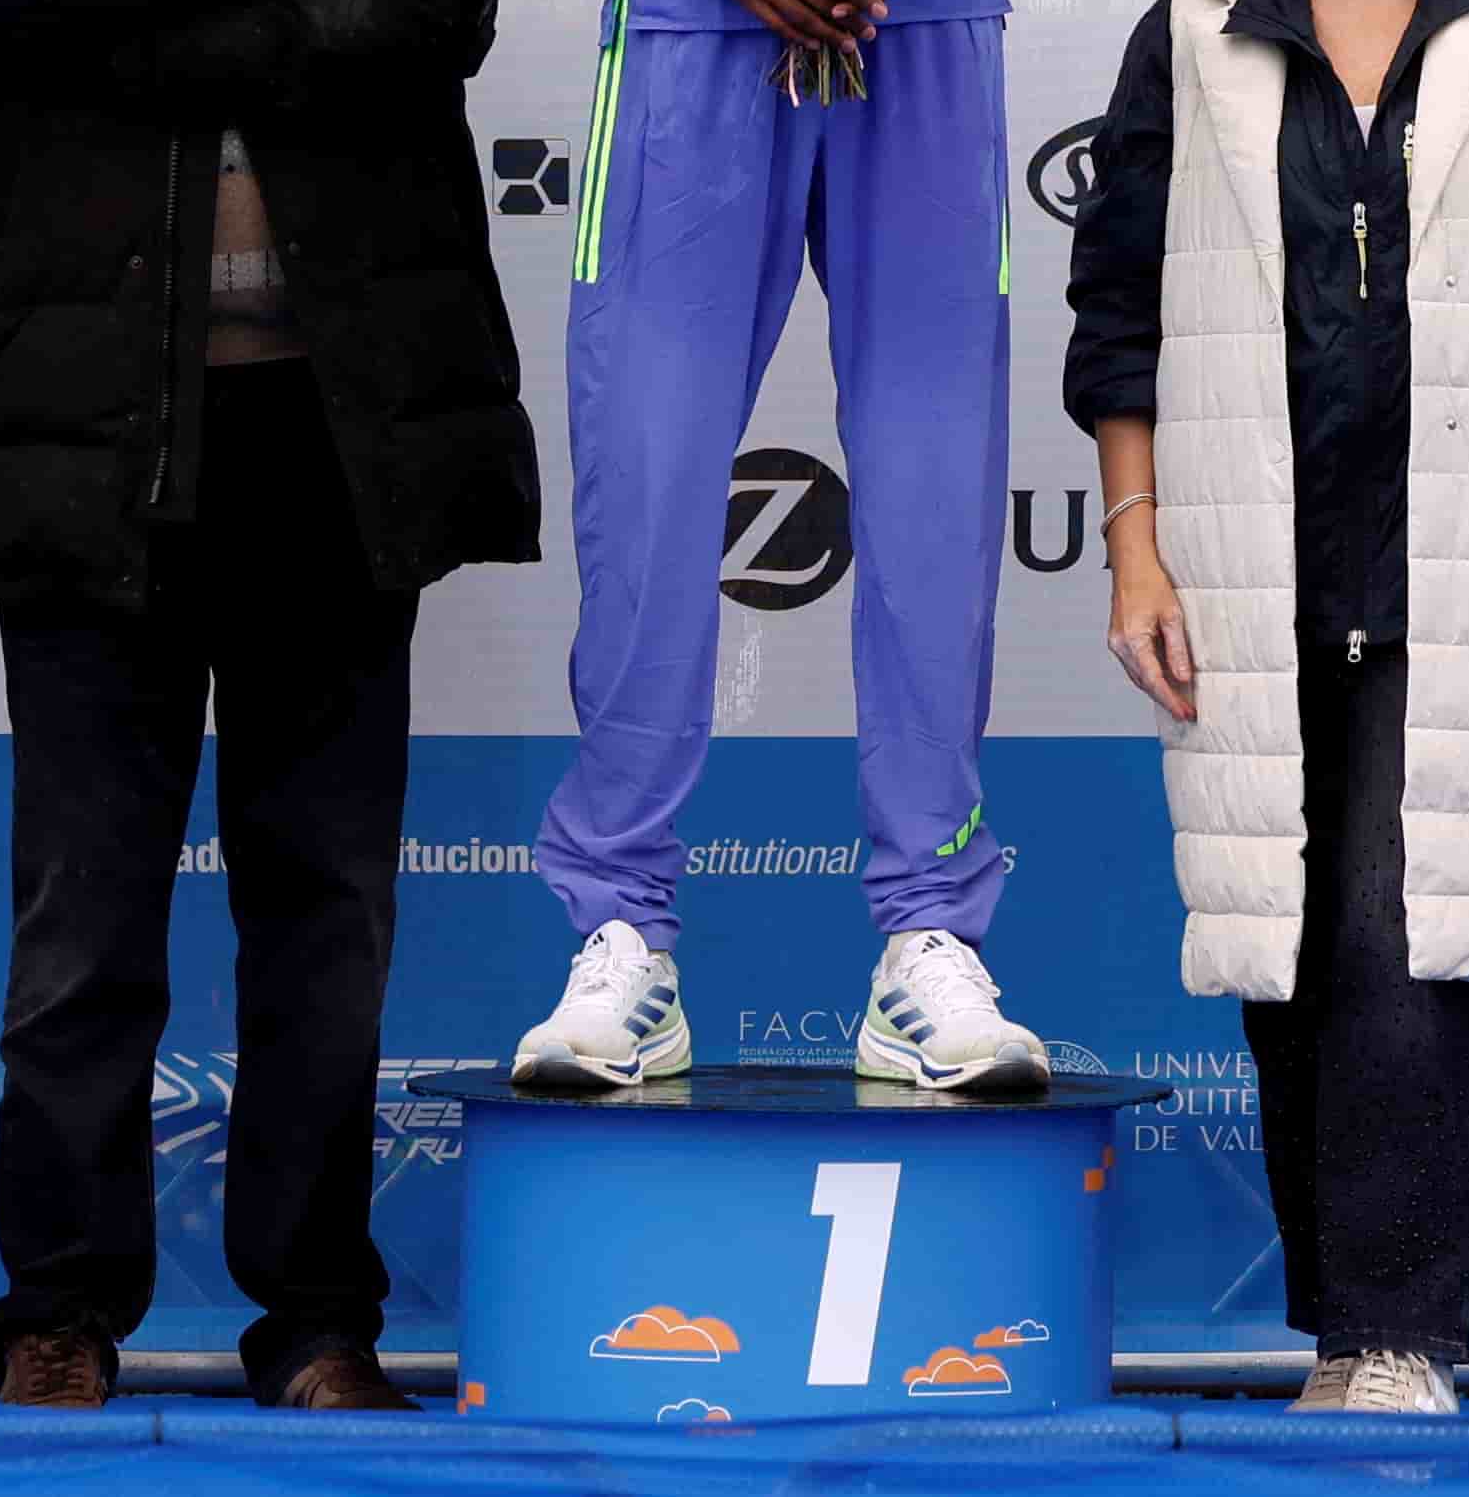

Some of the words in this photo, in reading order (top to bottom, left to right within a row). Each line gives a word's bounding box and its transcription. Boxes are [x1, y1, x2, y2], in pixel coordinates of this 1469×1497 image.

[739, 1010, 861, 1041] FACV
[1135, 1080, 1259, 1116] OLITÈ
[1134, 1124, 1180, 1151] DE
[807, 1163, 900, 1385] 1
